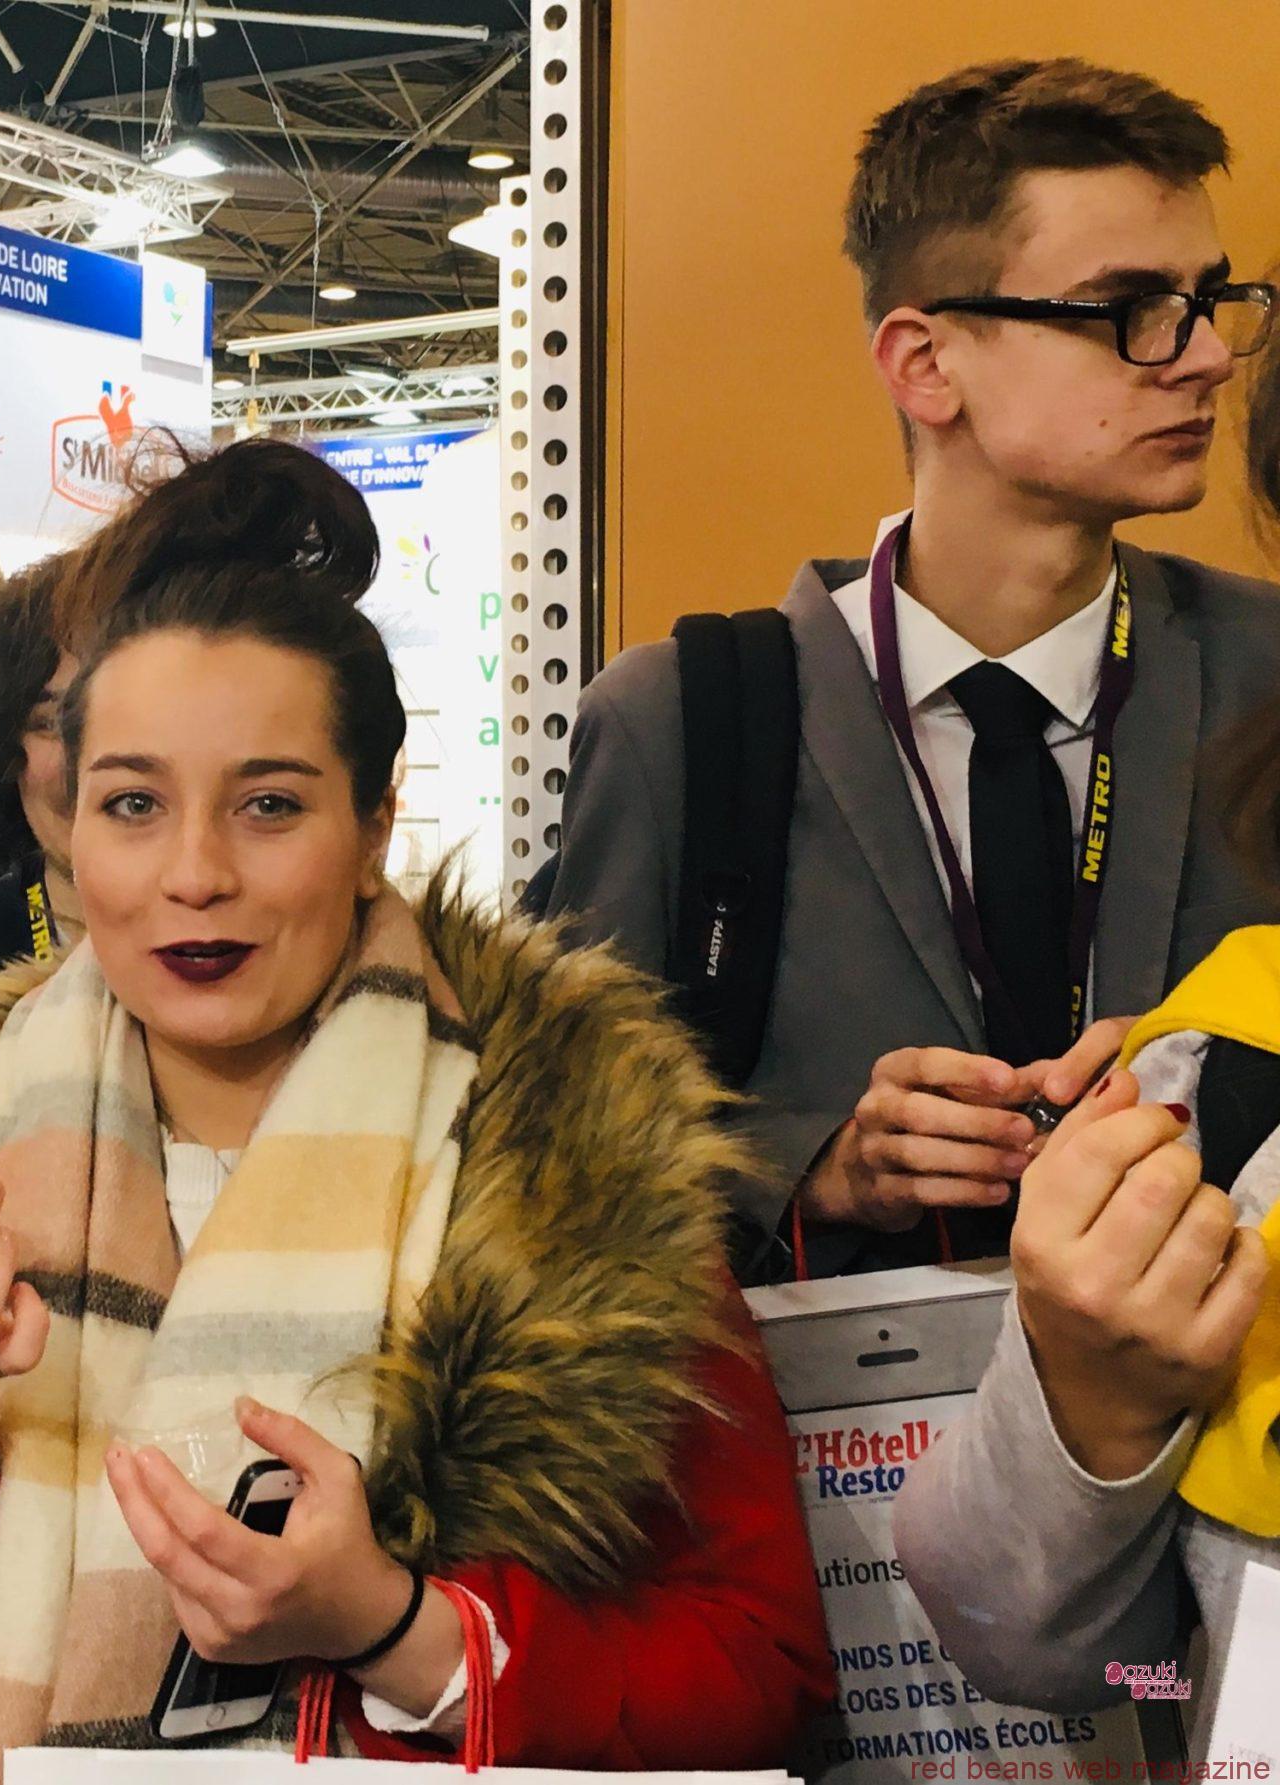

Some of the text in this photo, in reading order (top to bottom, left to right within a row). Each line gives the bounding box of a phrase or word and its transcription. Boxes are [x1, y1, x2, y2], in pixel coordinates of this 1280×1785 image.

[22, 250, 68, 282] LOIRE
[323, 447, 373, 468] ENTRE
[1082, 753, 1110, 882] METRO
[707, 919, 724, 977] EASTPA
[791, 1420, 929, 1475] L'Hôtell
[815, 1558, 905, 1588] utions
[899, 1640, 934, 1666] DE
[834, 1686, 900, 1715] LOGS
[905, 1681, 957, 1708] DES
[997, 1716, 1096, 1748] ÉCOLES
